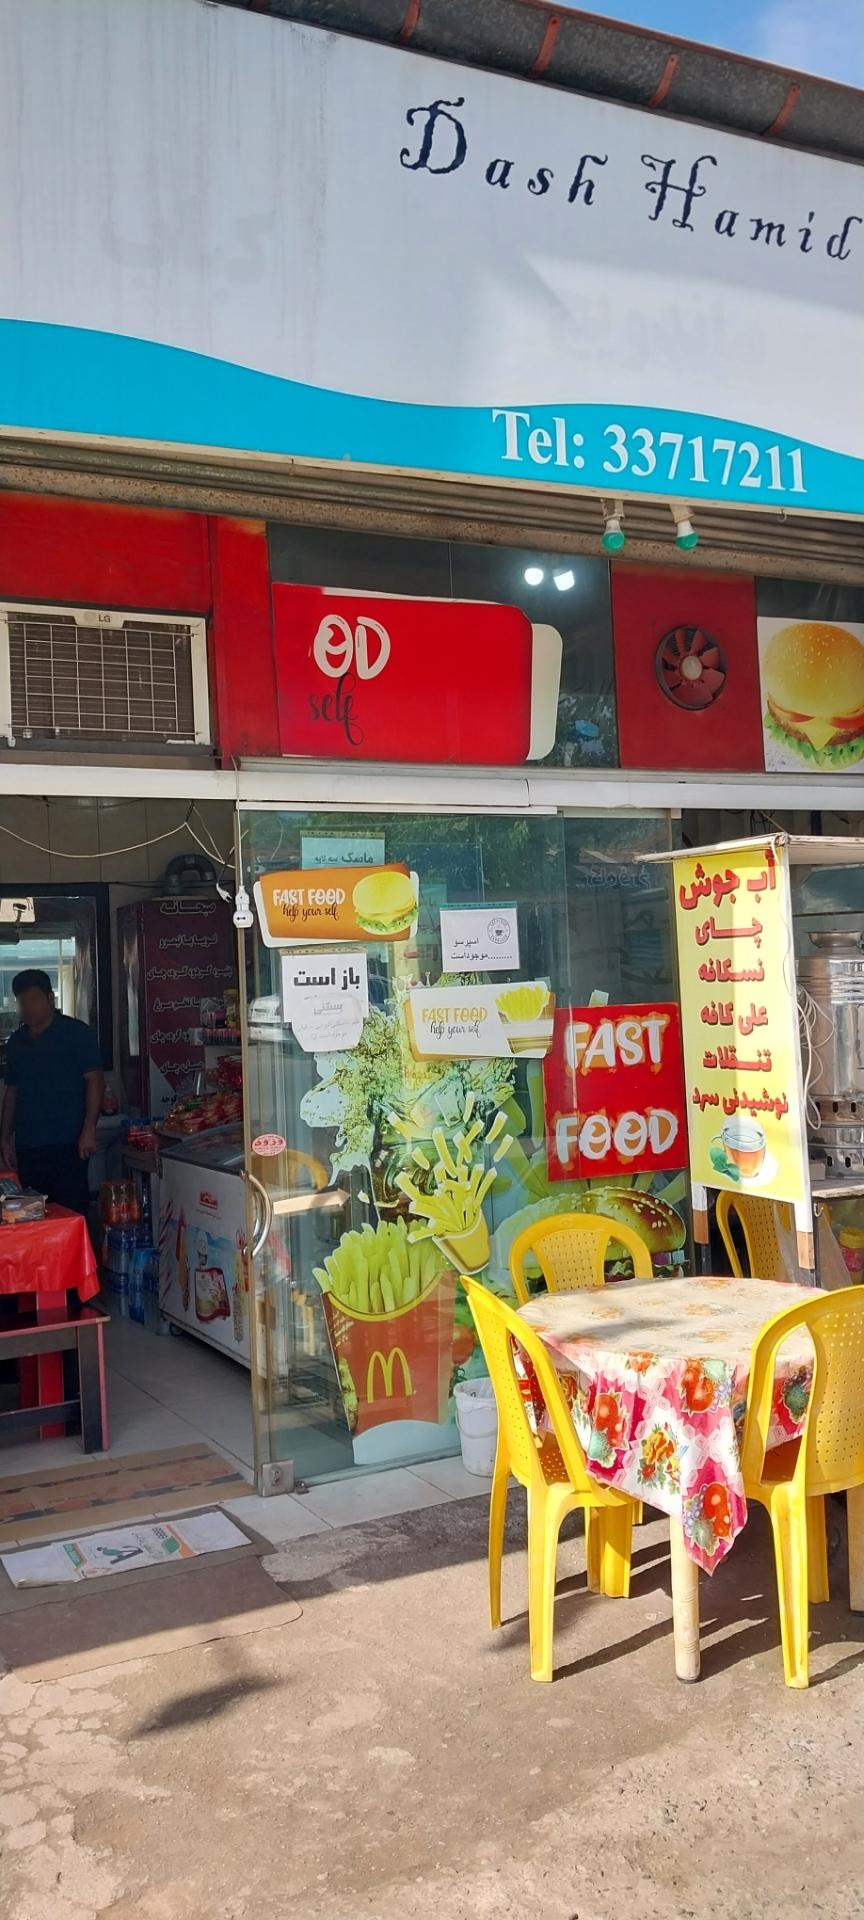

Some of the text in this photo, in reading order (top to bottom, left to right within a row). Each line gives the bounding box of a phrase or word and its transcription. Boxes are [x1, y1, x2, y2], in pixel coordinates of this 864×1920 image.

[400, 97, 863, 260] Dash Hamid
[492, 409, 808, 493] Tel: 33717211
[98, 614, 111, 623] LG
[341, 852, 374, 865] ماسک
[272, 888, 346, 906] FAST FOOD
[680, 863, 740, 910] جوش
[283, 903, 299, 922] help
[302, 908, 322, 922] your
[695, 916, 763, 948] چای
[294, 967, 360, 990] باز است
[698, 958, 764, 983] نسکافه
[421, 1006, 488, 1023] FAST FOOD
[700, 1001, 768, 1036] علی کافه
[430, 1020, 445, 1039] help
[447, 1025, 465, 1039] your
[565, 1019, 668, 1070] FAST
[702, 1045, 772, 1072] تنقلات
[692, 1087, 788, 1120] نوشیدنی سرد
[555, 1108, 679, 1165] FOOD
